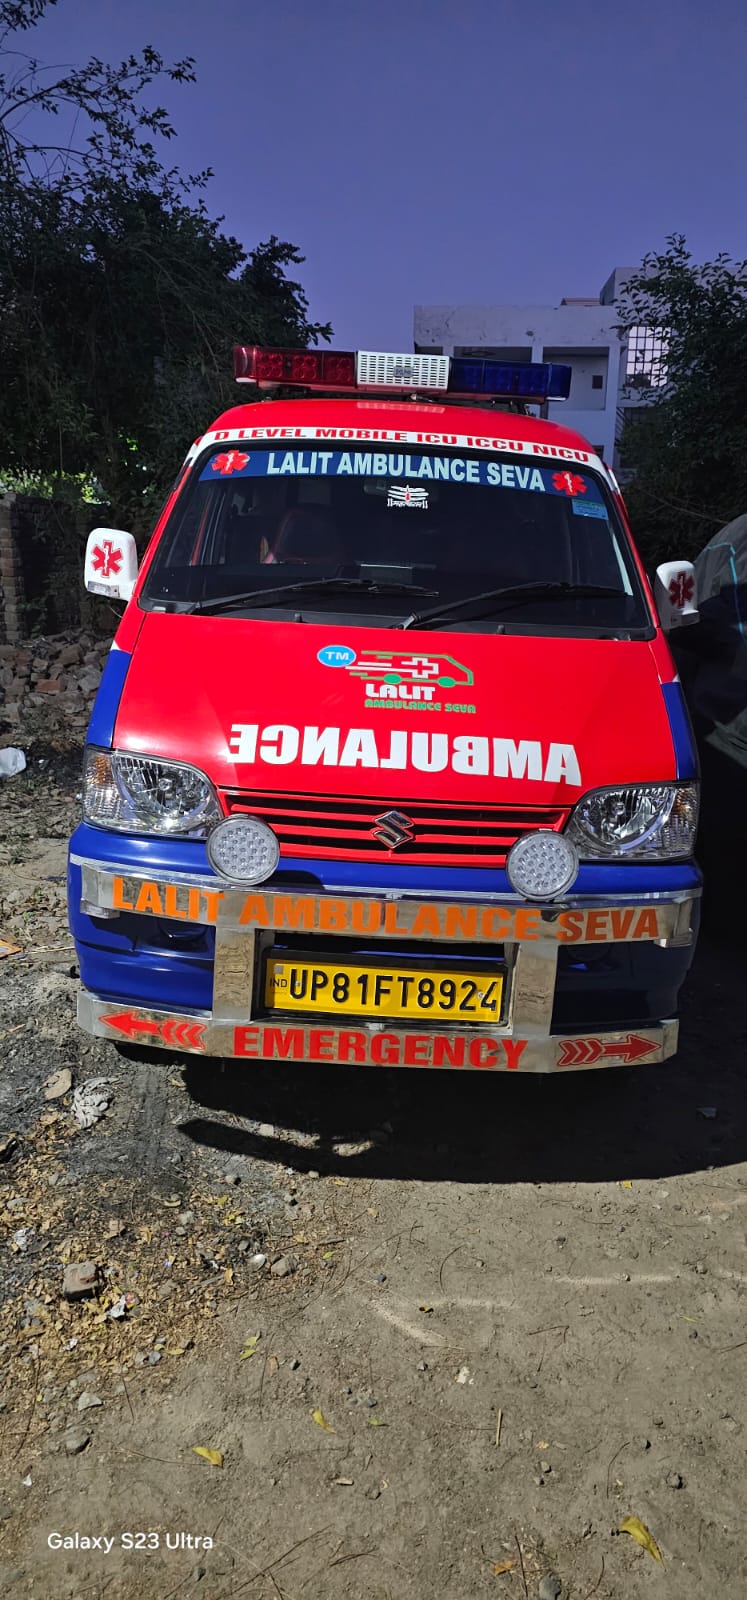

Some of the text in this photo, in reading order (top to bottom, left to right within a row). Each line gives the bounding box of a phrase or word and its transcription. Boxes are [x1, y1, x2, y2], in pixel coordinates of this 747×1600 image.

[214, 428, 588, 463] D LEVEL MOBILE ICU ICCU NICU
[267, 451, 546, 492] LALIT AMBULANCE SEVA
[325, 651, 349, 661] TM
[364, 698, 476, 714] AMBULANCE SEVA
[365, 683, 436, 701] LALIT
[112, 877, 659, 941] LALIT AMBULANCE SEVA
[270, 968, 498, 1011] IND UP81FT8924
[233, 1027, 528, 1070] EMERGENCY
